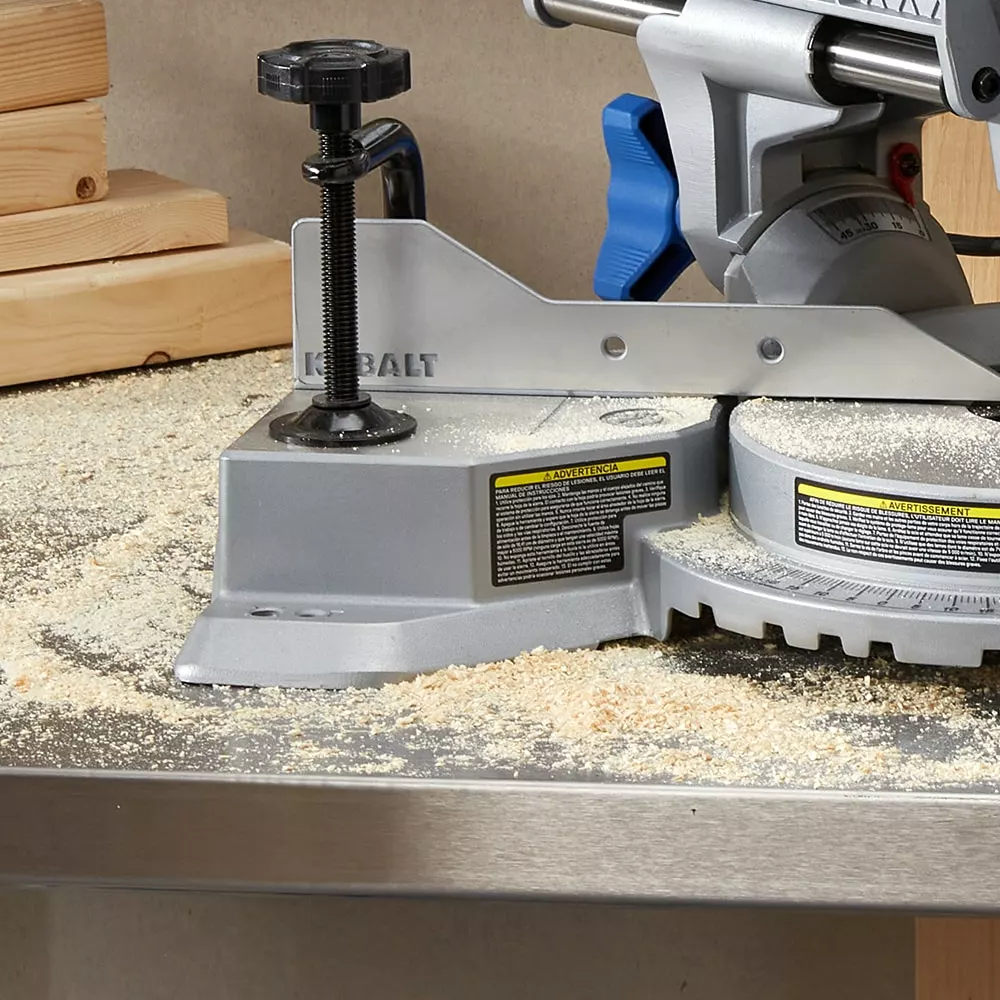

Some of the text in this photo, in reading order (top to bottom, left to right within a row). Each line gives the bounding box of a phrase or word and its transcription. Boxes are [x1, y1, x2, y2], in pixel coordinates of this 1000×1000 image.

[840, 228, 854, 240] 45
[864, 220, 879, 231] 30
[891, 220, 903, 231] 15
[305, 352, 438, 377] KBALT
[553, 463, 619, 480] ADVERTENCIA
[526, 486, 569, 496] INSTRUCCIONES
[888, 501, 971, 516] AVERTISSEMENT
[910, 513, 949, 521] L'UTILISATEUR
